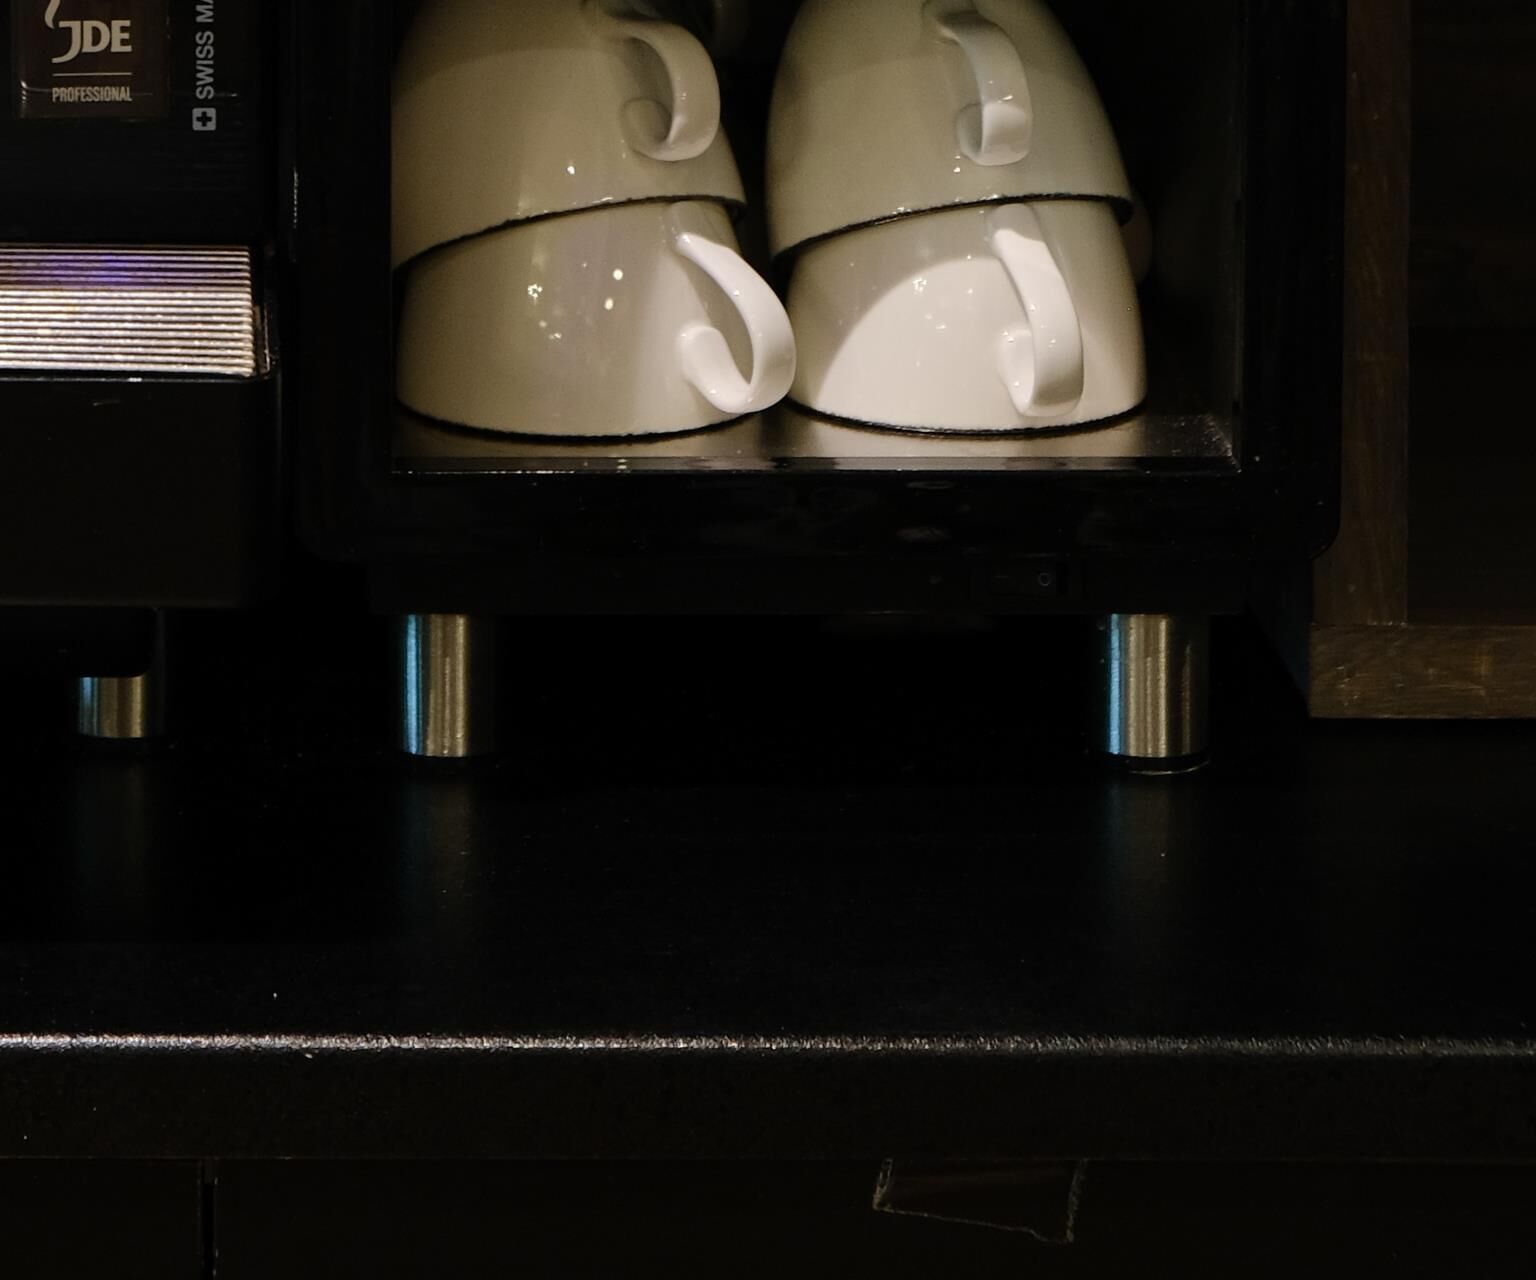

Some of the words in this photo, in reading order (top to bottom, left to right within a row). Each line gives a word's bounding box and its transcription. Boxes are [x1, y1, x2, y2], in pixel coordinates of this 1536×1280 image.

[51, 20, 133, 64] JDE
[195, 30, 214, 100] SWISS
[52, 86, 133, 103] PROFESSIONAL
